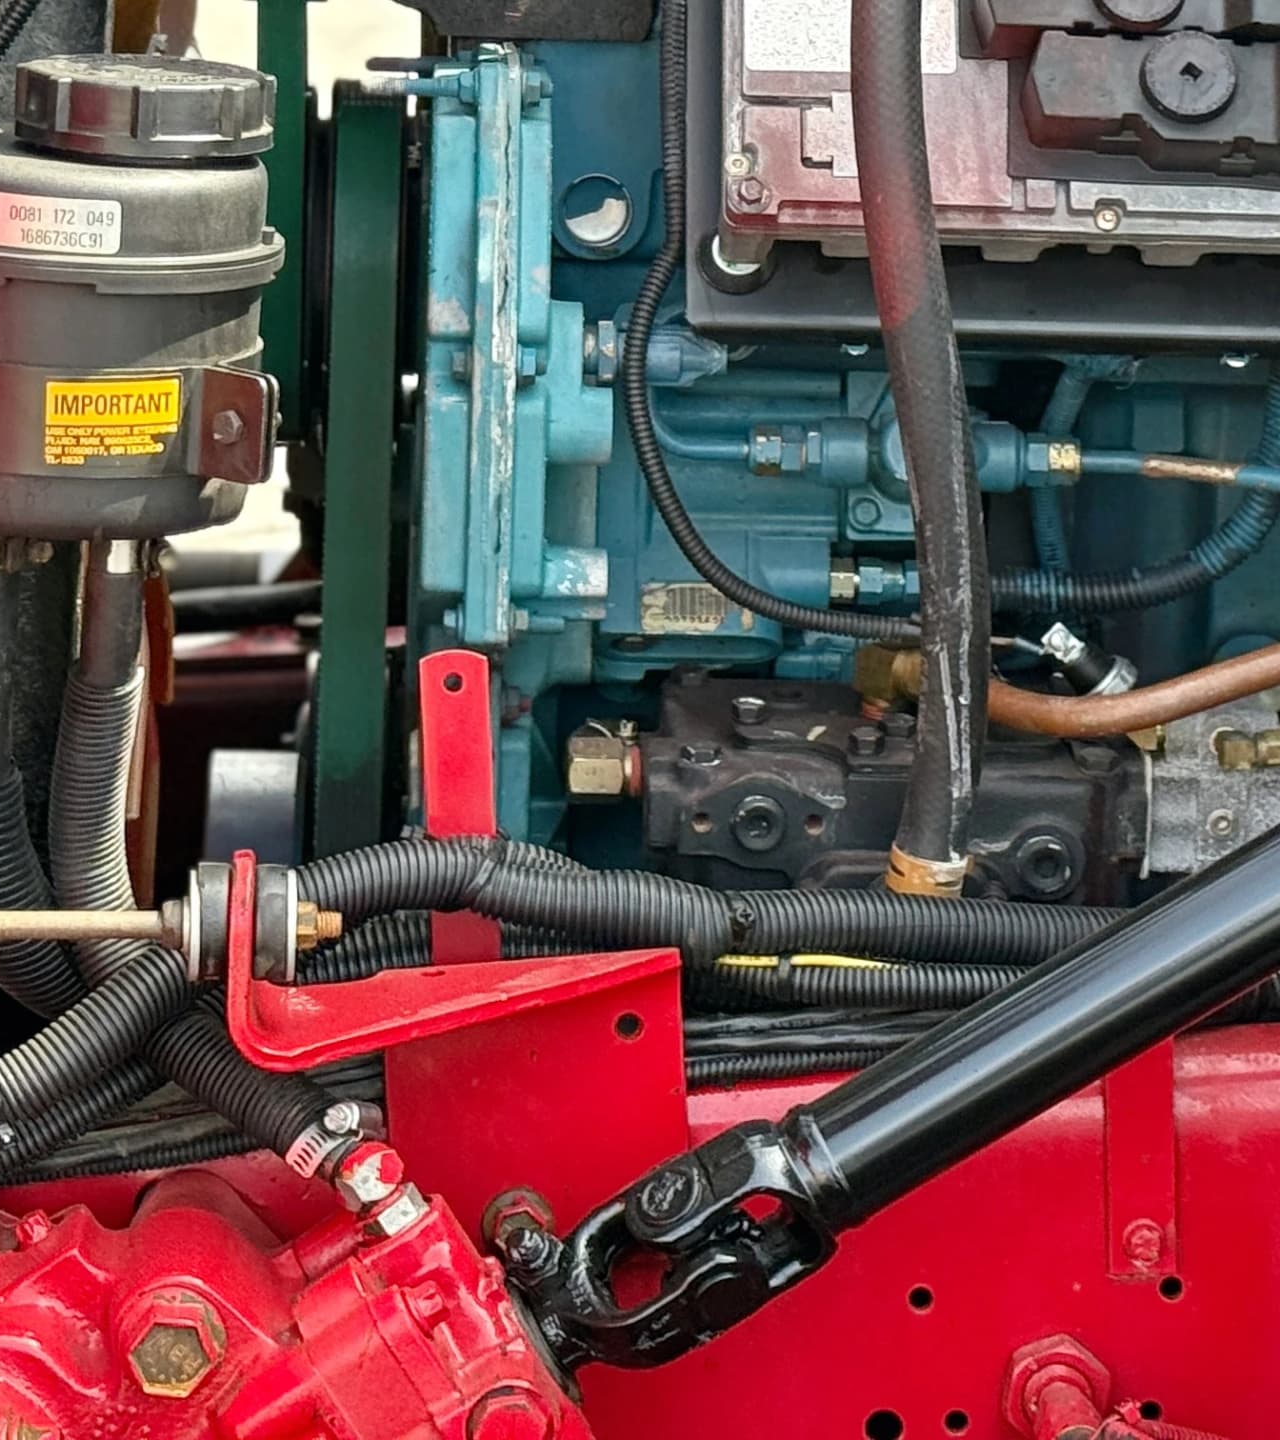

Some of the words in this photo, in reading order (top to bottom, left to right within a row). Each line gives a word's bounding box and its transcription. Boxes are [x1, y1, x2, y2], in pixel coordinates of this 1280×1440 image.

[9, 205, 43, 223] 0081
[53, 208, 76, 226] 172
[86, 210, 115, 227] 049
[54, 392, 173, 417] IMPORTANT
